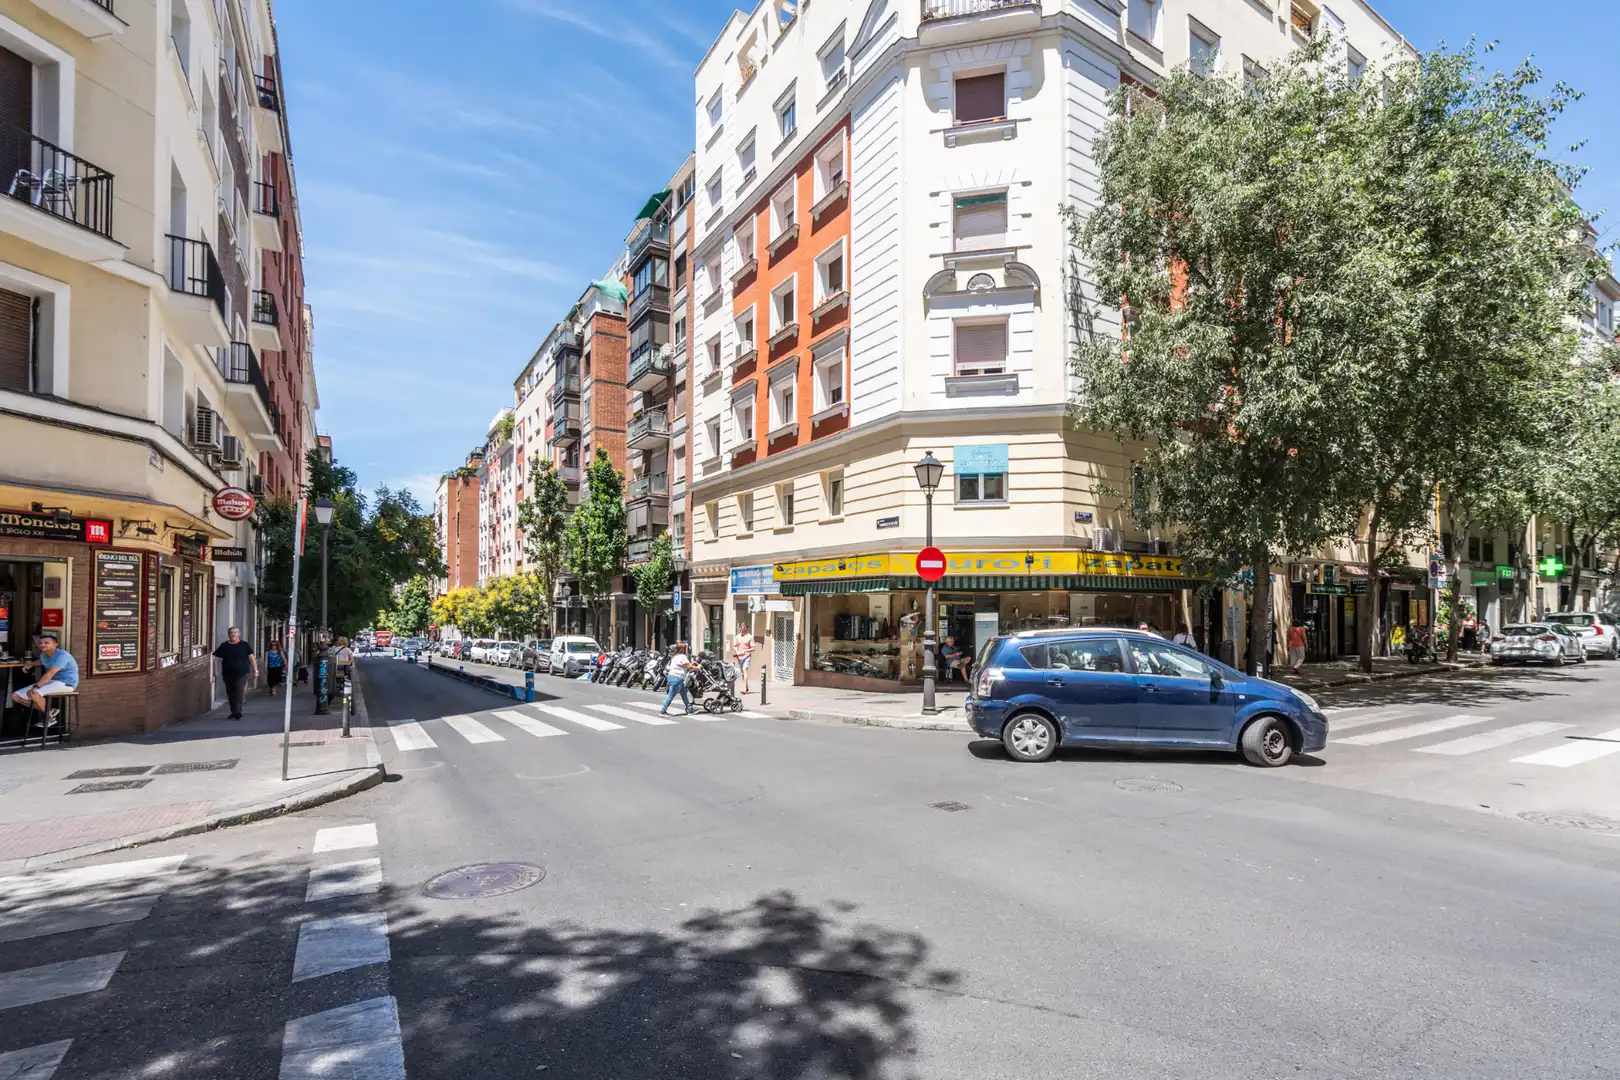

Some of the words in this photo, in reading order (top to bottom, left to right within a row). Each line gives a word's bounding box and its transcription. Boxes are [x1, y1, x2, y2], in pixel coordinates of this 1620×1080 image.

[217, 498, 250, 507] Mahou
[6, 527, 31, 535] SIGLO
[214, 548, 243, 557] Mahou
[947, 555, 1053, 570] urori
[781, 559, 883, 577] zapaos
